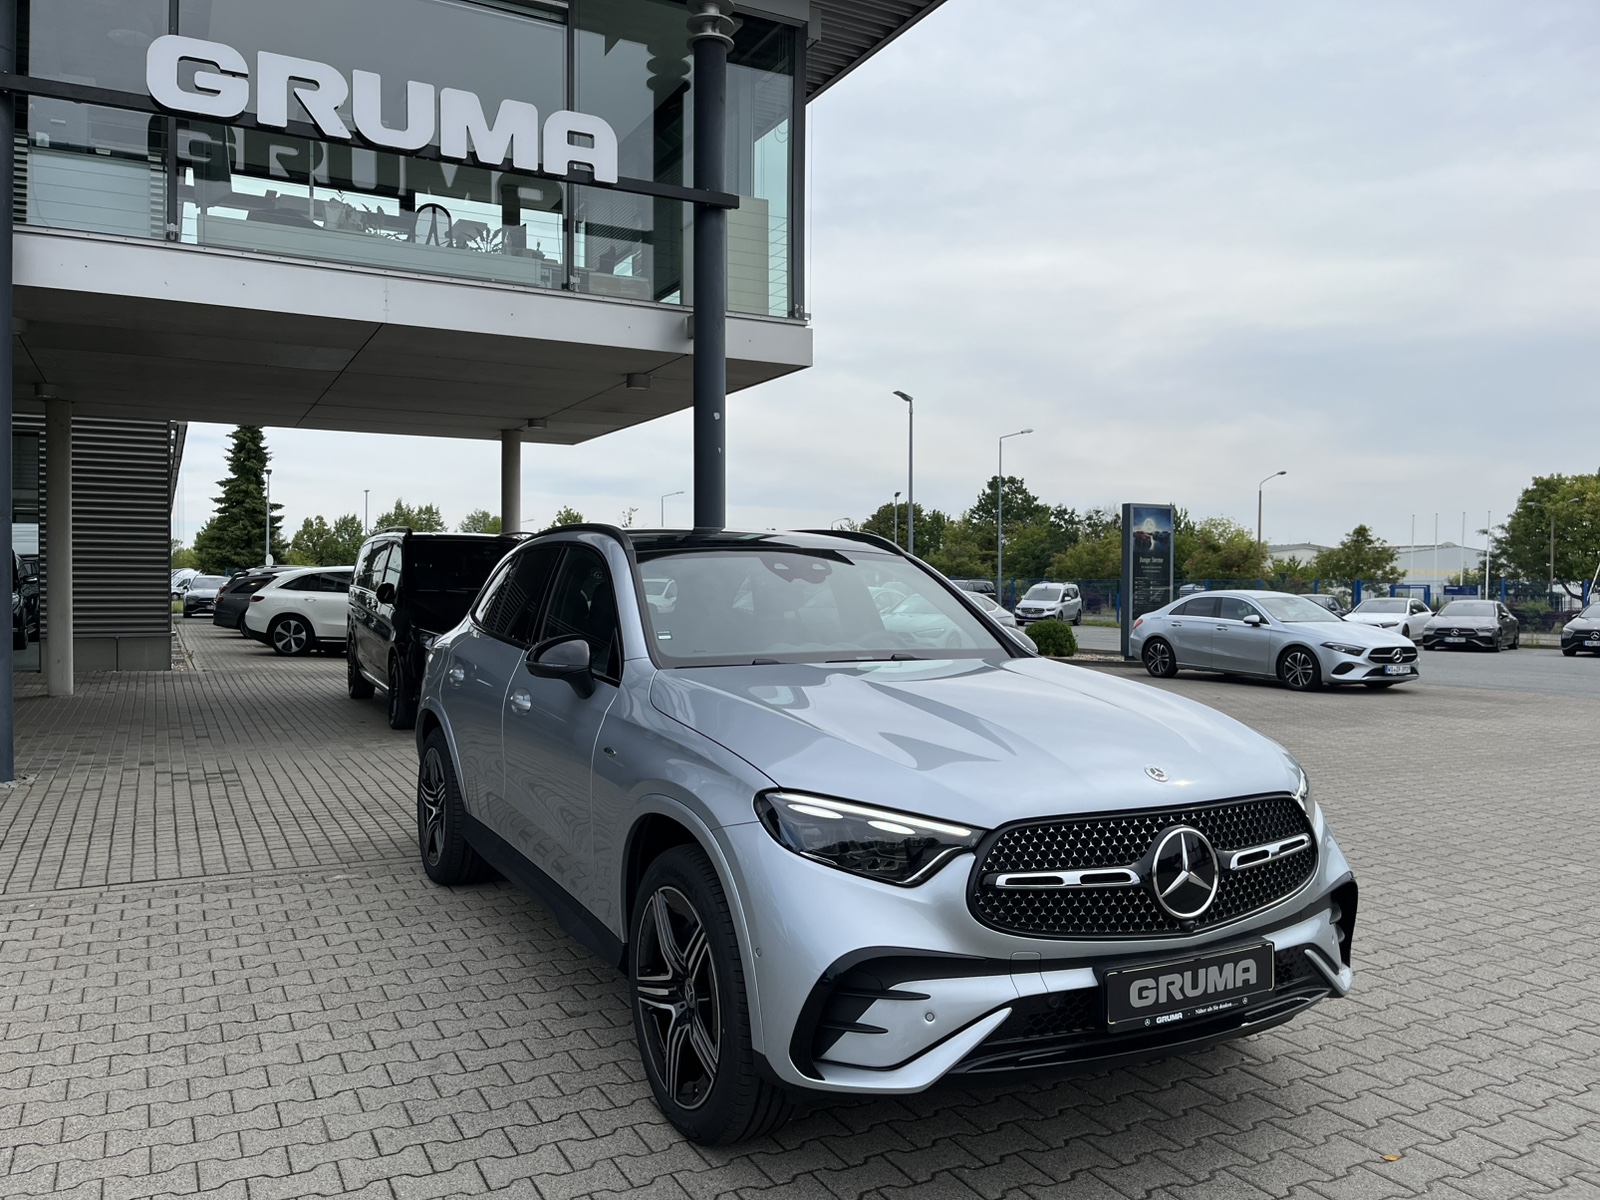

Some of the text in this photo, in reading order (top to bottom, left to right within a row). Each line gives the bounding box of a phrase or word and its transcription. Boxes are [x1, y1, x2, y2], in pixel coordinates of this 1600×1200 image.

[146, 35, 618, 184] GRUMA
[1139, 556, 1151, 564] Junge
[1129, 958, 1257, 1008] GRUMA
[1156, 1012, 1183, 1024] GRUMA
